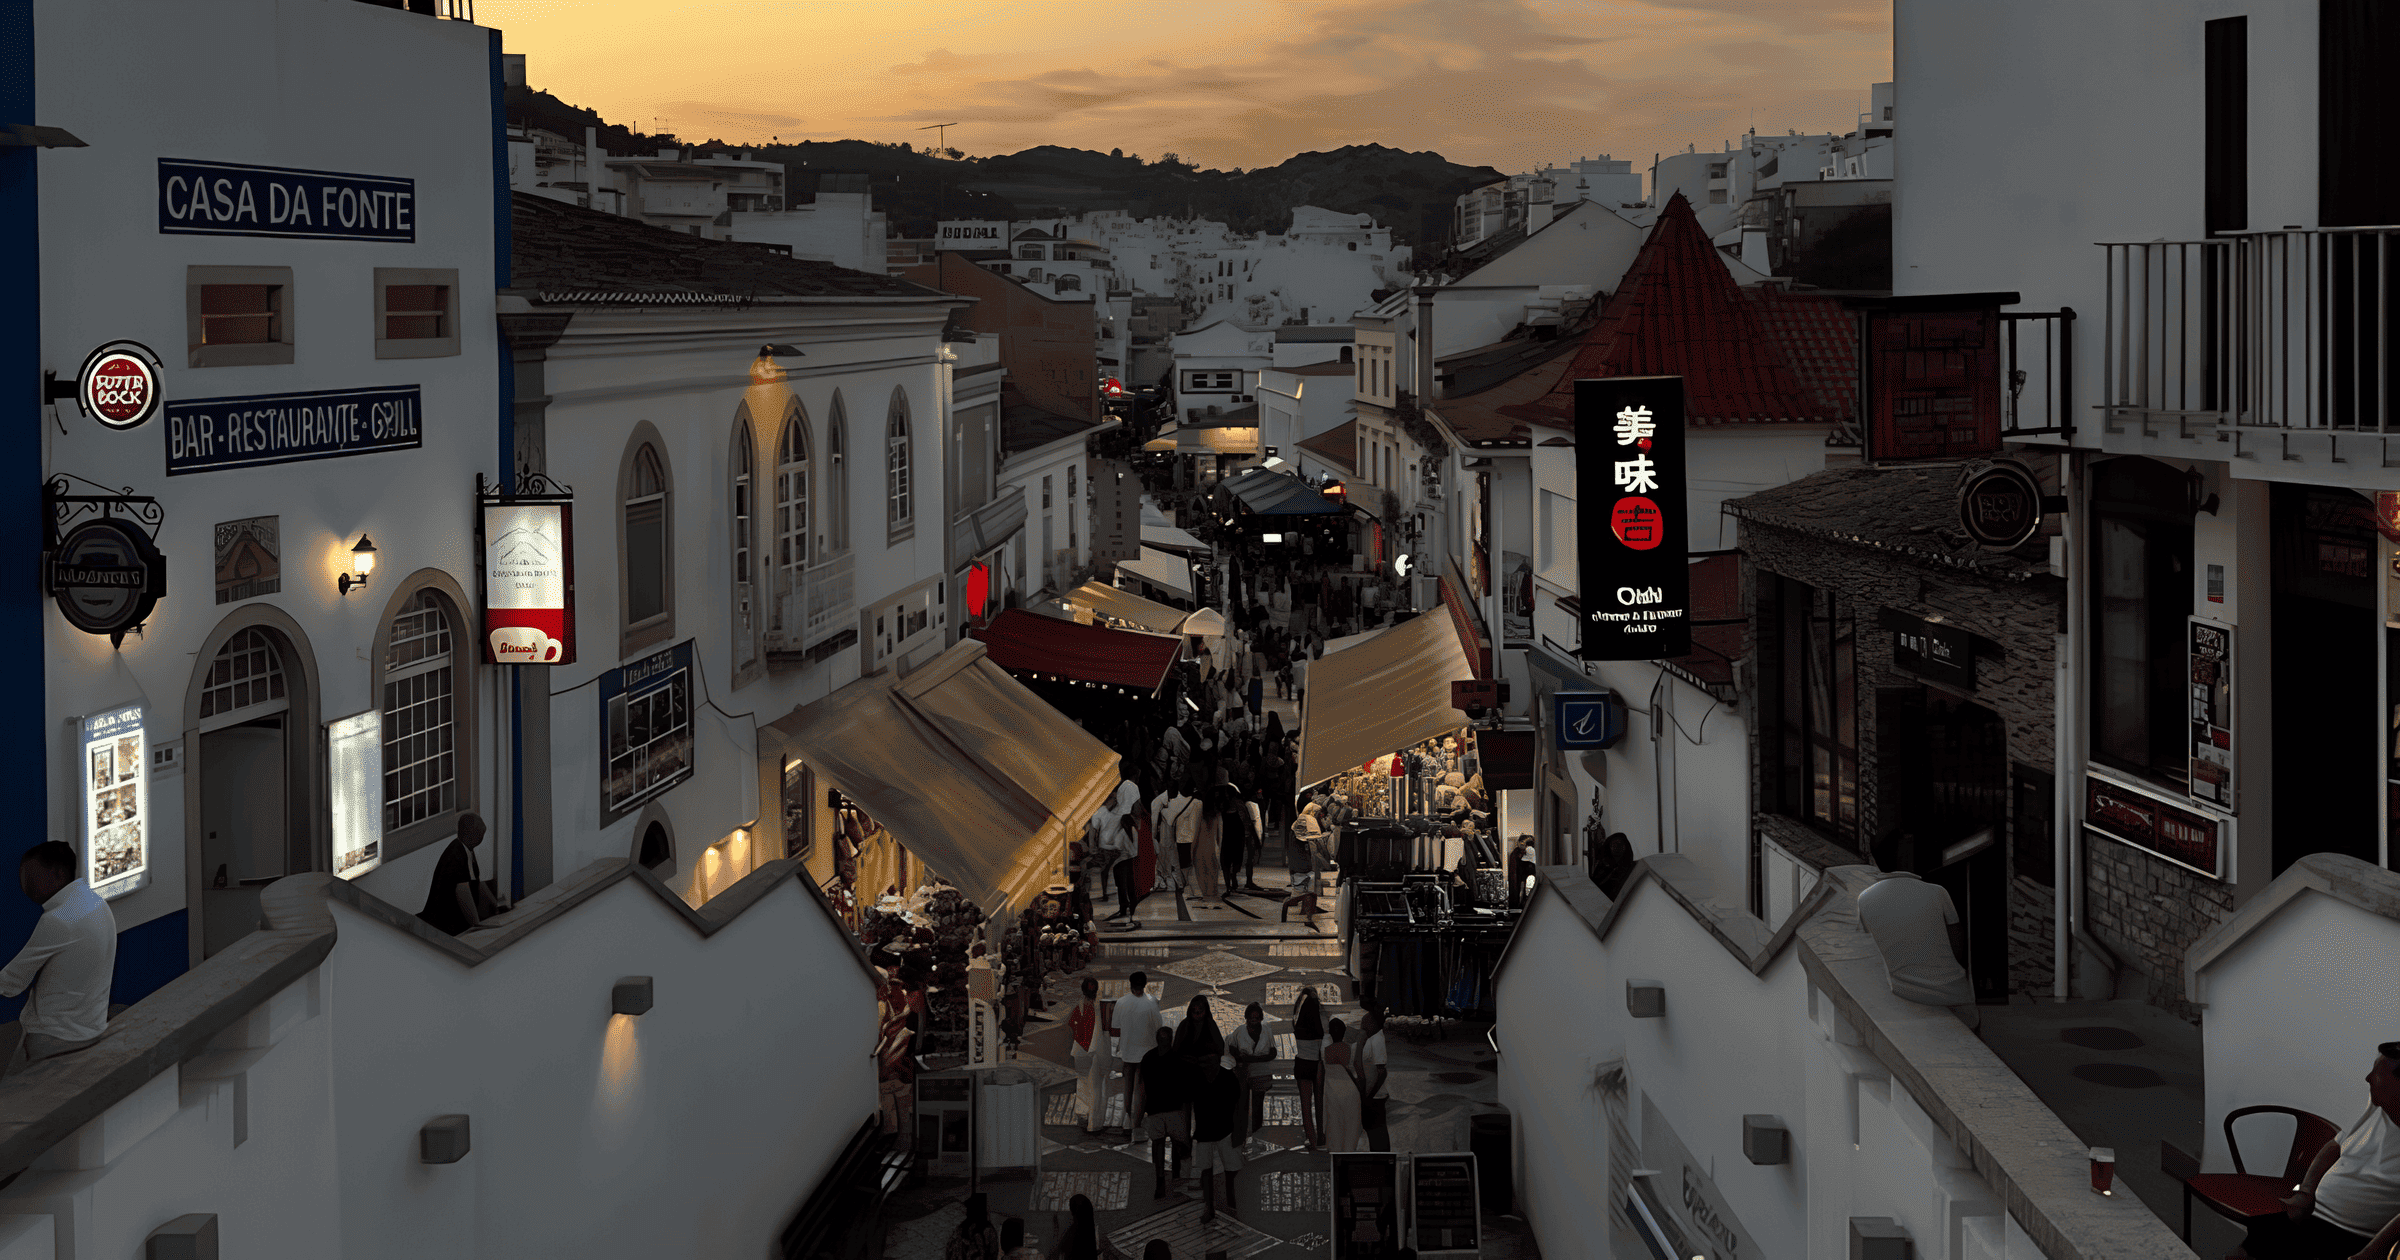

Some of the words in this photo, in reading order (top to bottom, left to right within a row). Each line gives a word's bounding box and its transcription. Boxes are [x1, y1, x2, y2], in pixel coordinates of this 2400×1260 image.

[167, 175, 258, 223] CASA
[270, 182, 312, 226] DA
[323, 186, 412, 230] FONTE
